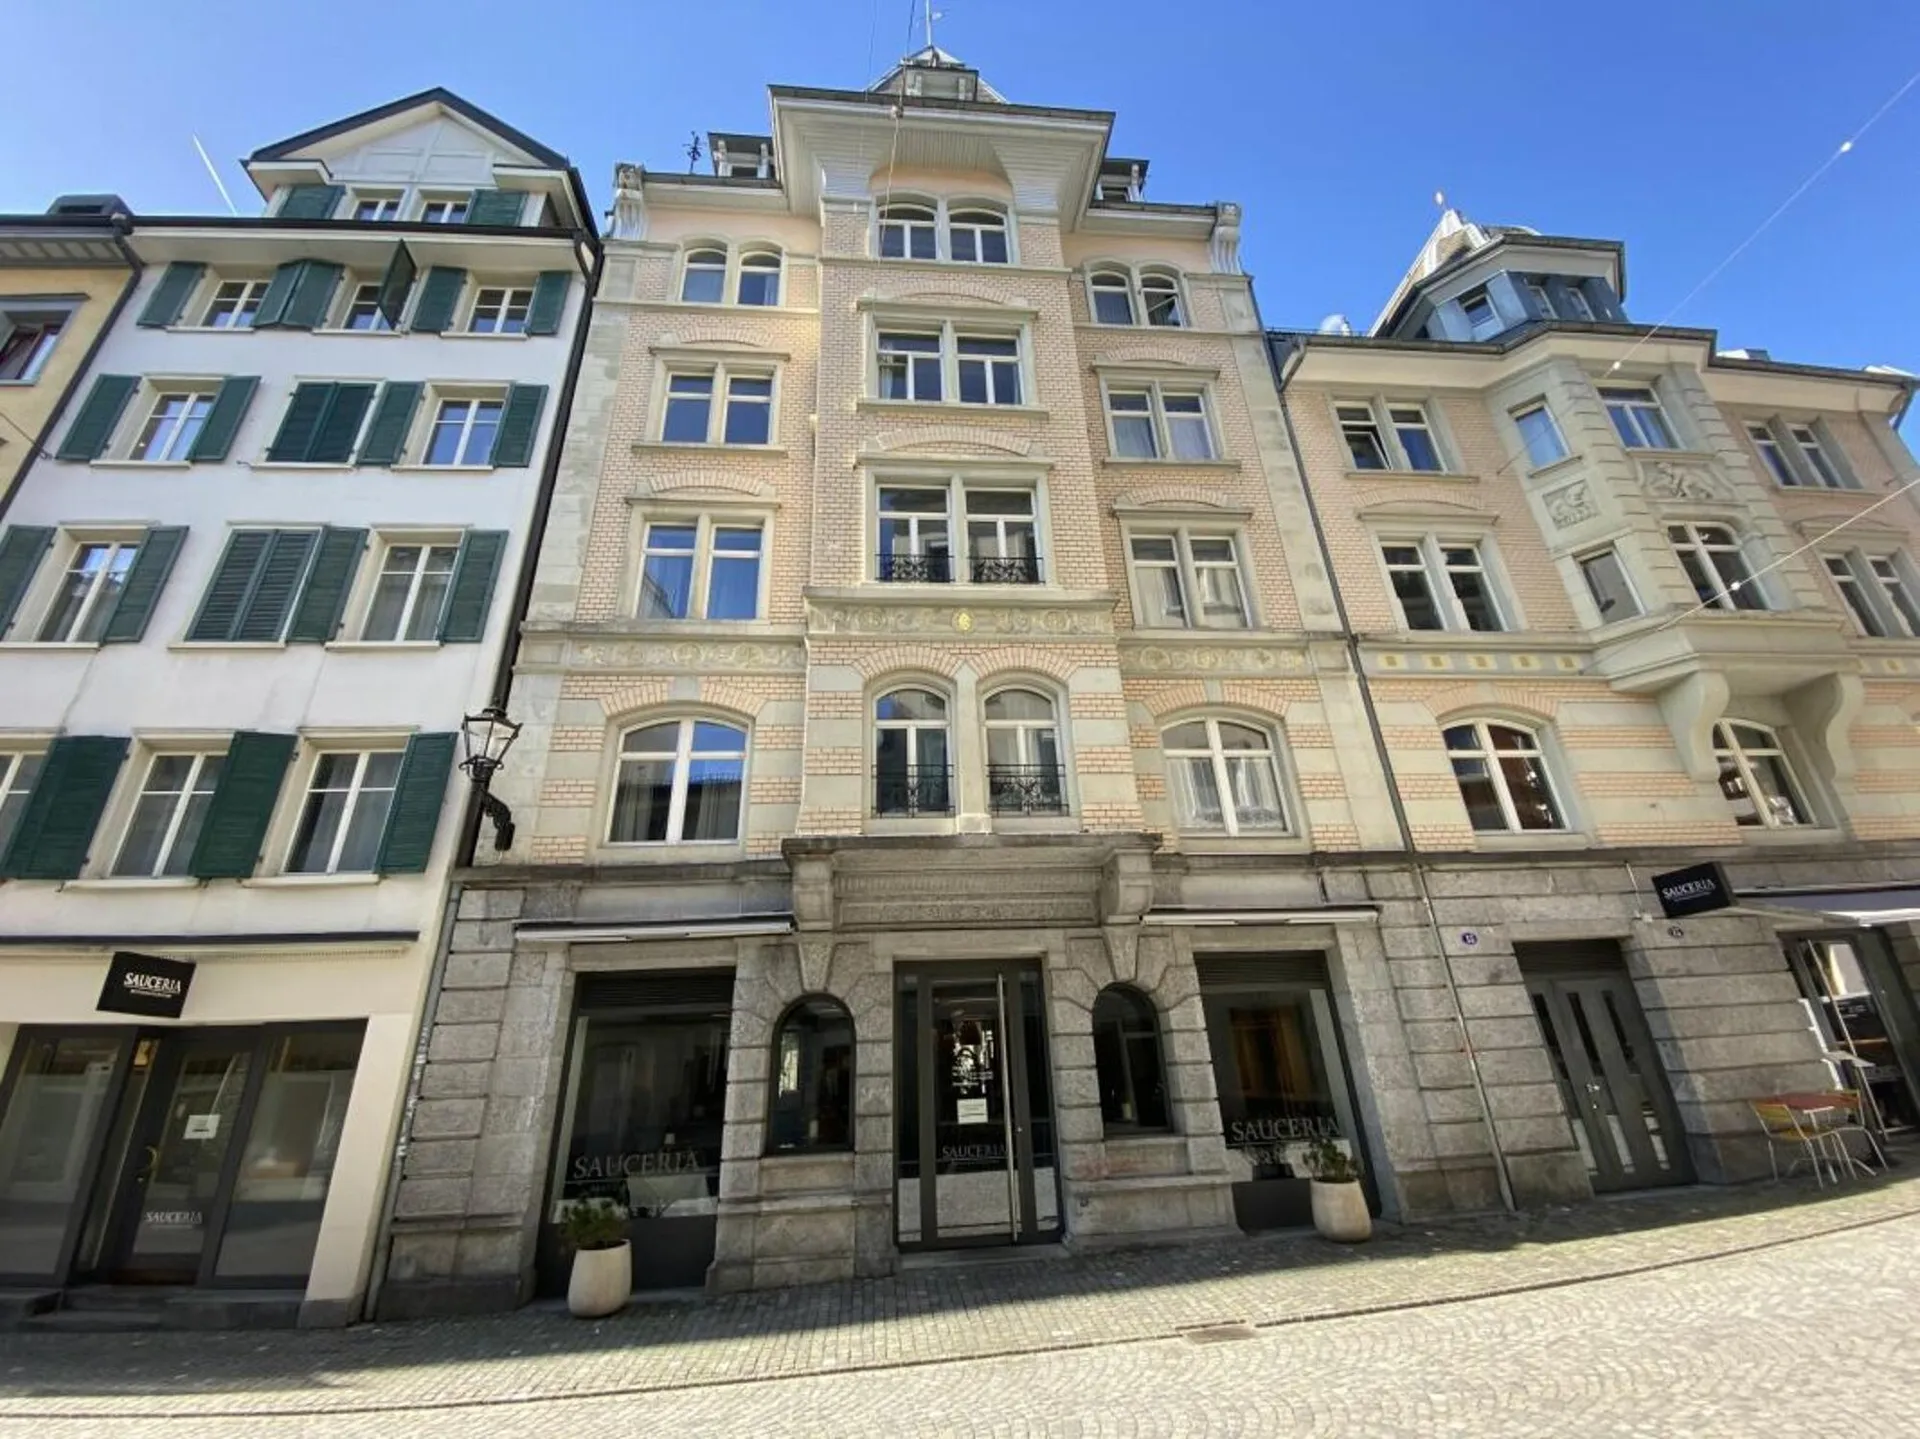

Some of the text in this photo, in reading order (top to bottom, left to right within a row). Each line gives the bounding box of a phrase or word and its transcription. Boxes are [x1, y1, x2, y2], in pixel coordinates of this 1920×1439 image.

[1662, 879, 1716, 899] SAUCERIA
[124, 972, 181, 993] SAUCERIA
[1231, 1116, 1343, 1141] SAUCERIA
[573, 1150, 699, 1178] SAUCERIA
[145, 1210, 202, 1224] SAUCERIA
